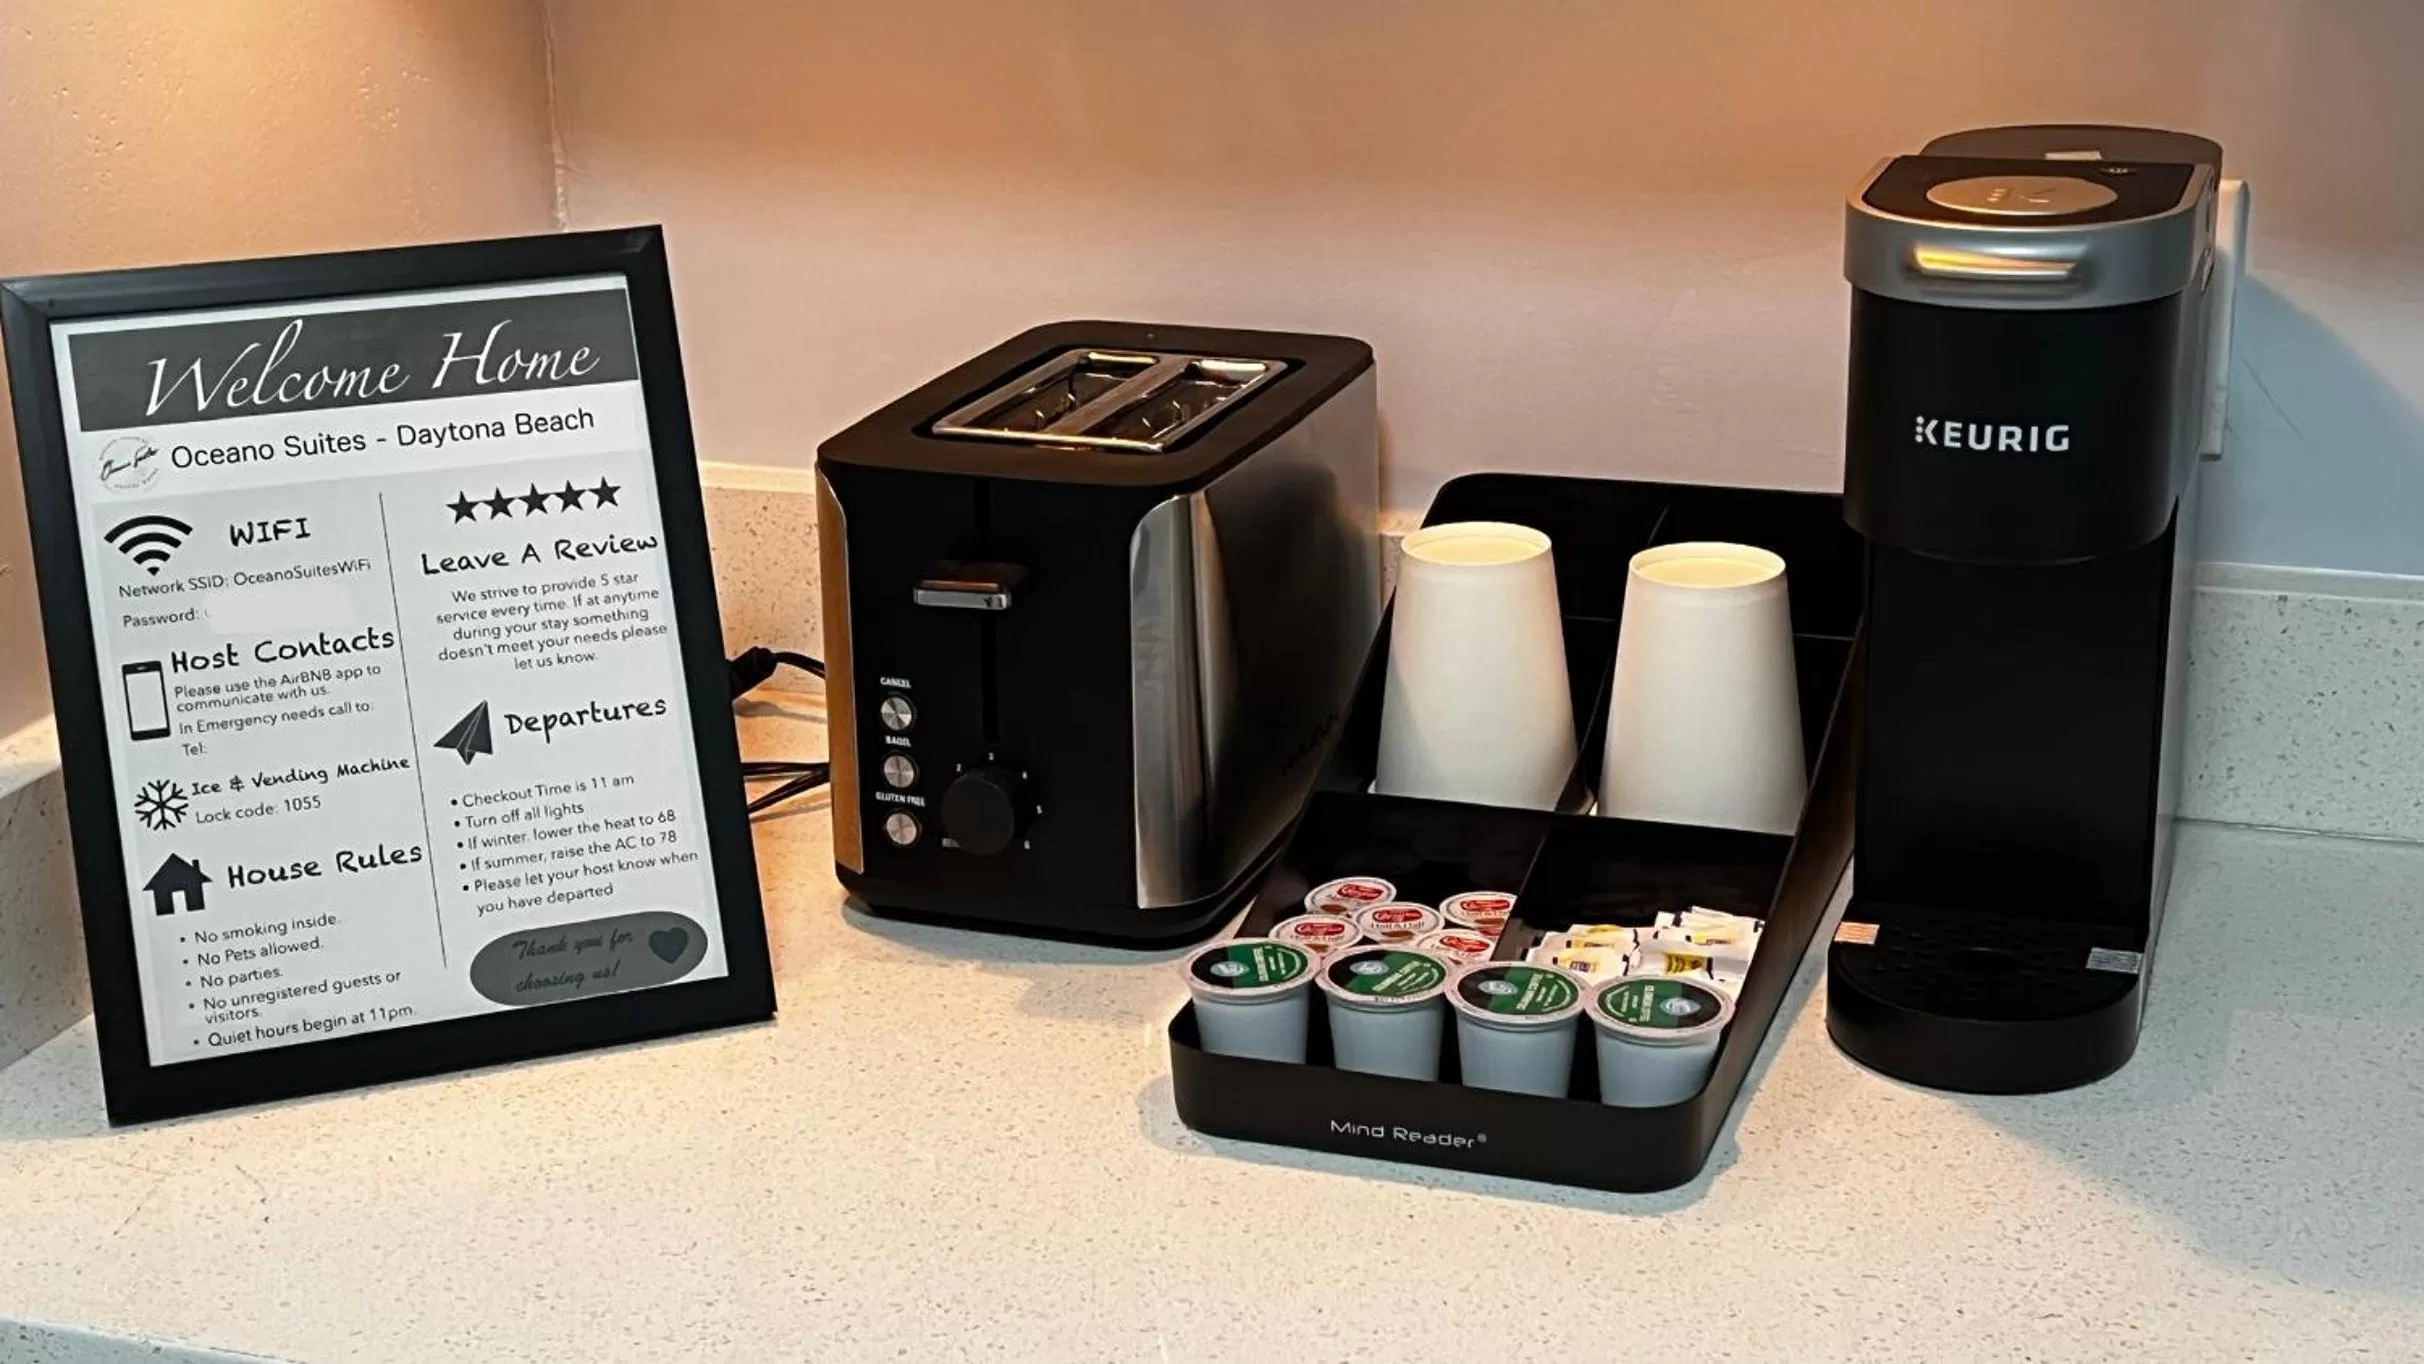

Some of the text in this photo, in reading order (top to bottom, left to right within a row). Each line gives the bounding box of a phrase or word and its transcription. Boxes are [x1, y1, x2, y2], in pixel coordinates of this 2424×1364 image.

[144, 317, 601, 417] Welcome Home
[170, 442, 276, 470] Oceano
[282, 431, 368, 459] Suites
[375, 436, 388, 444] -
[395, 419, 507, 450] Daytona
[513, 406, 596, 437] Beach
[1915, 416, 2070, 452] KEURIG
[228, 515, 313, 549] WIFI
[420, 532, 660, 577] Leave A Review
[117, 557, 373, 600] Network SSID: OceanoSuitesWiFi
[450, 572, 640, 605] We strive to provide 5 star
[121, 606, 201, 629] Password:
[435, 607, 489, 626] service
[489, 603, 532, 620] every
[571, 592, 584, 609] If
[585, 594, 602, 608] at
[599, 588, 661, 607] anytime
[451, 607, 650, 642] during your stay something
[169, 625, 396, 675] Host Contacts
[437, 623, 669, 663] doesn't meet your needs please
[512, 656, 535, 671] let
[534, 655, 555, 669] us
[172, 664, 383, 700] Please use the AirBNB app to
[175, 691, 275, 714] communicate
[276, 684, 309, 702] with
[177, 721, 194, 736] In
[195, 713, 279, 734] Emergency
[279, 704, 326, 723] needs
[326, 700, 354, 717] call
[502, 697, 668, 746] Departures
[190, 757, 412, 797] Ice & Vending Machine
[460, 774, 636, 809] Checkout Time is 11 am
[194, 806, 233, 826] Lock
[282, 793, 322, 814] 1055
[463, 801, 586, 830] Turn off all lights
[466, 834, 479, 852] If
[531, 825, 575, 842] lower
[575, 820, 602, 836] the
[602, 815, 637, 832] heat
[637, 814, 656, 828] to
[656, 807, 678, 825] 68
[226, 842, 424, 890] House Rules
[470, 828, 679, 873] If summer, raise the AC to 78
[473, 850, 700, 894] Please let your host know when
[475, 881, 615, 919] you have departed
[193, 928, 220, 945] No
[220, 921, 290, 942] smoking
[196, 934, 326, 968] No Pets allowed.
[198, 973, 226, 990] No
[201, 970, 402, 1014] No unregistered guests or
[206, 1028, 254, 1048] Quiet
[253, 1022, 302, 1042] hours
[300, 1014, 349, 1035] begin
[349, 1010, 367, 1026] at
[1330, 1119, 1385, 1138] Mind
